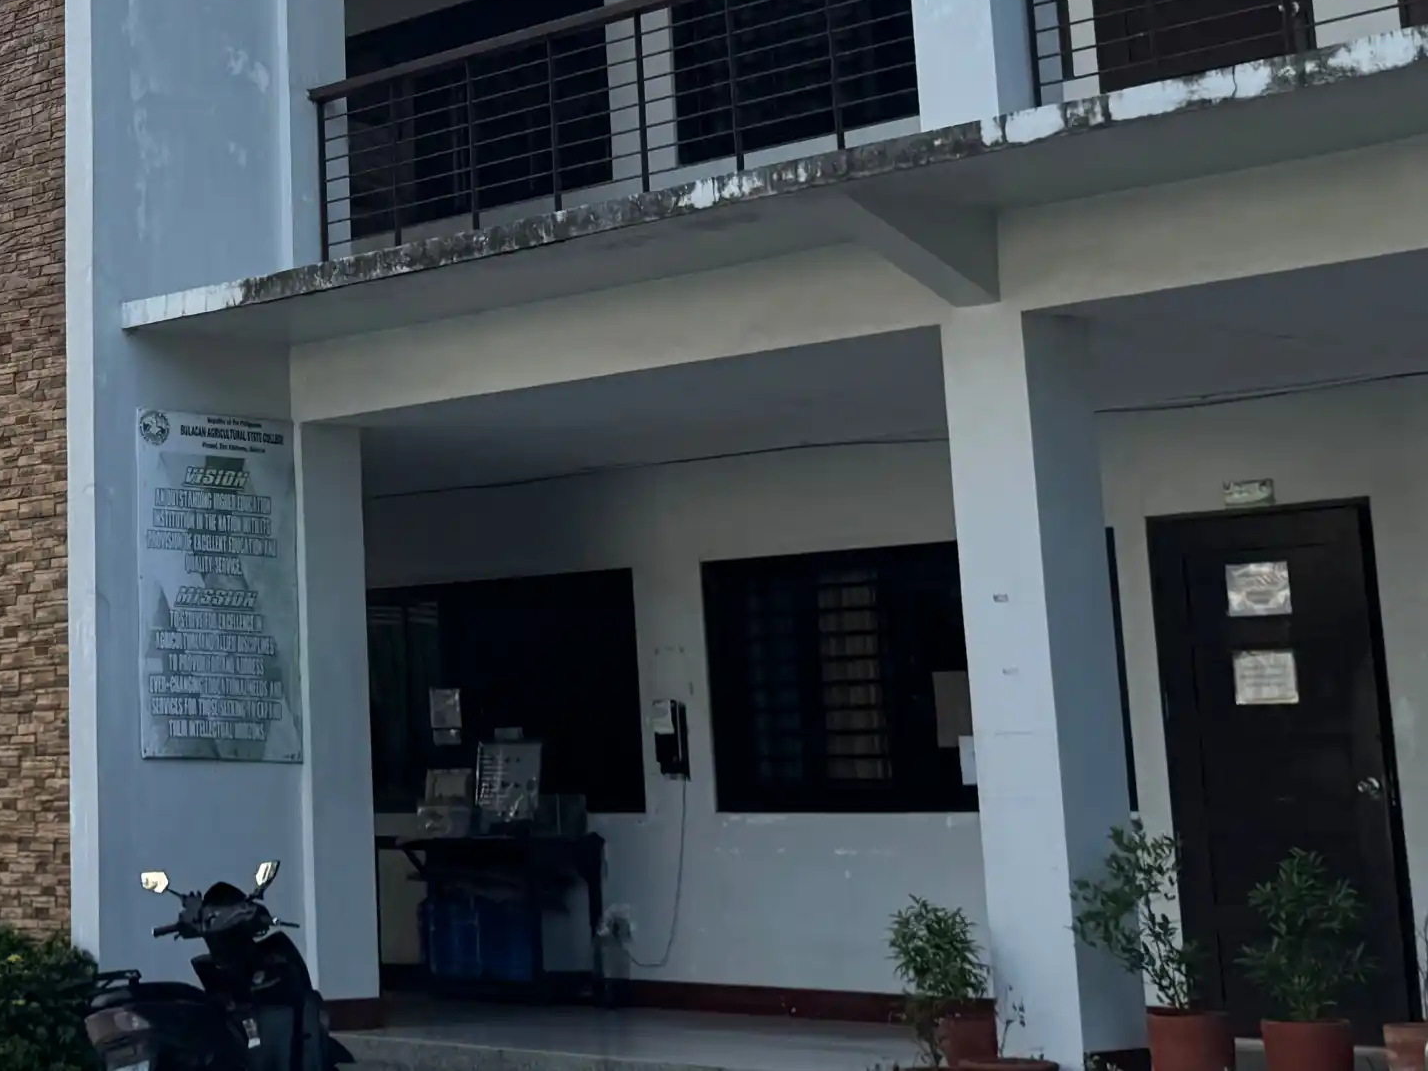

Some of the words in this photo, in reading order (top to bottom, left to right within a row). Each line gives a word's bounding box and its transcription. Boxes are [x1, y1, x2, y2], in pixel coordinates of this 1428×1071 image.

[180, 424, 206, 438] BULACAN
[207, 427, 246, 442] AGRICULTURAL
[194, 533, 227, 553] EXCELLENT
